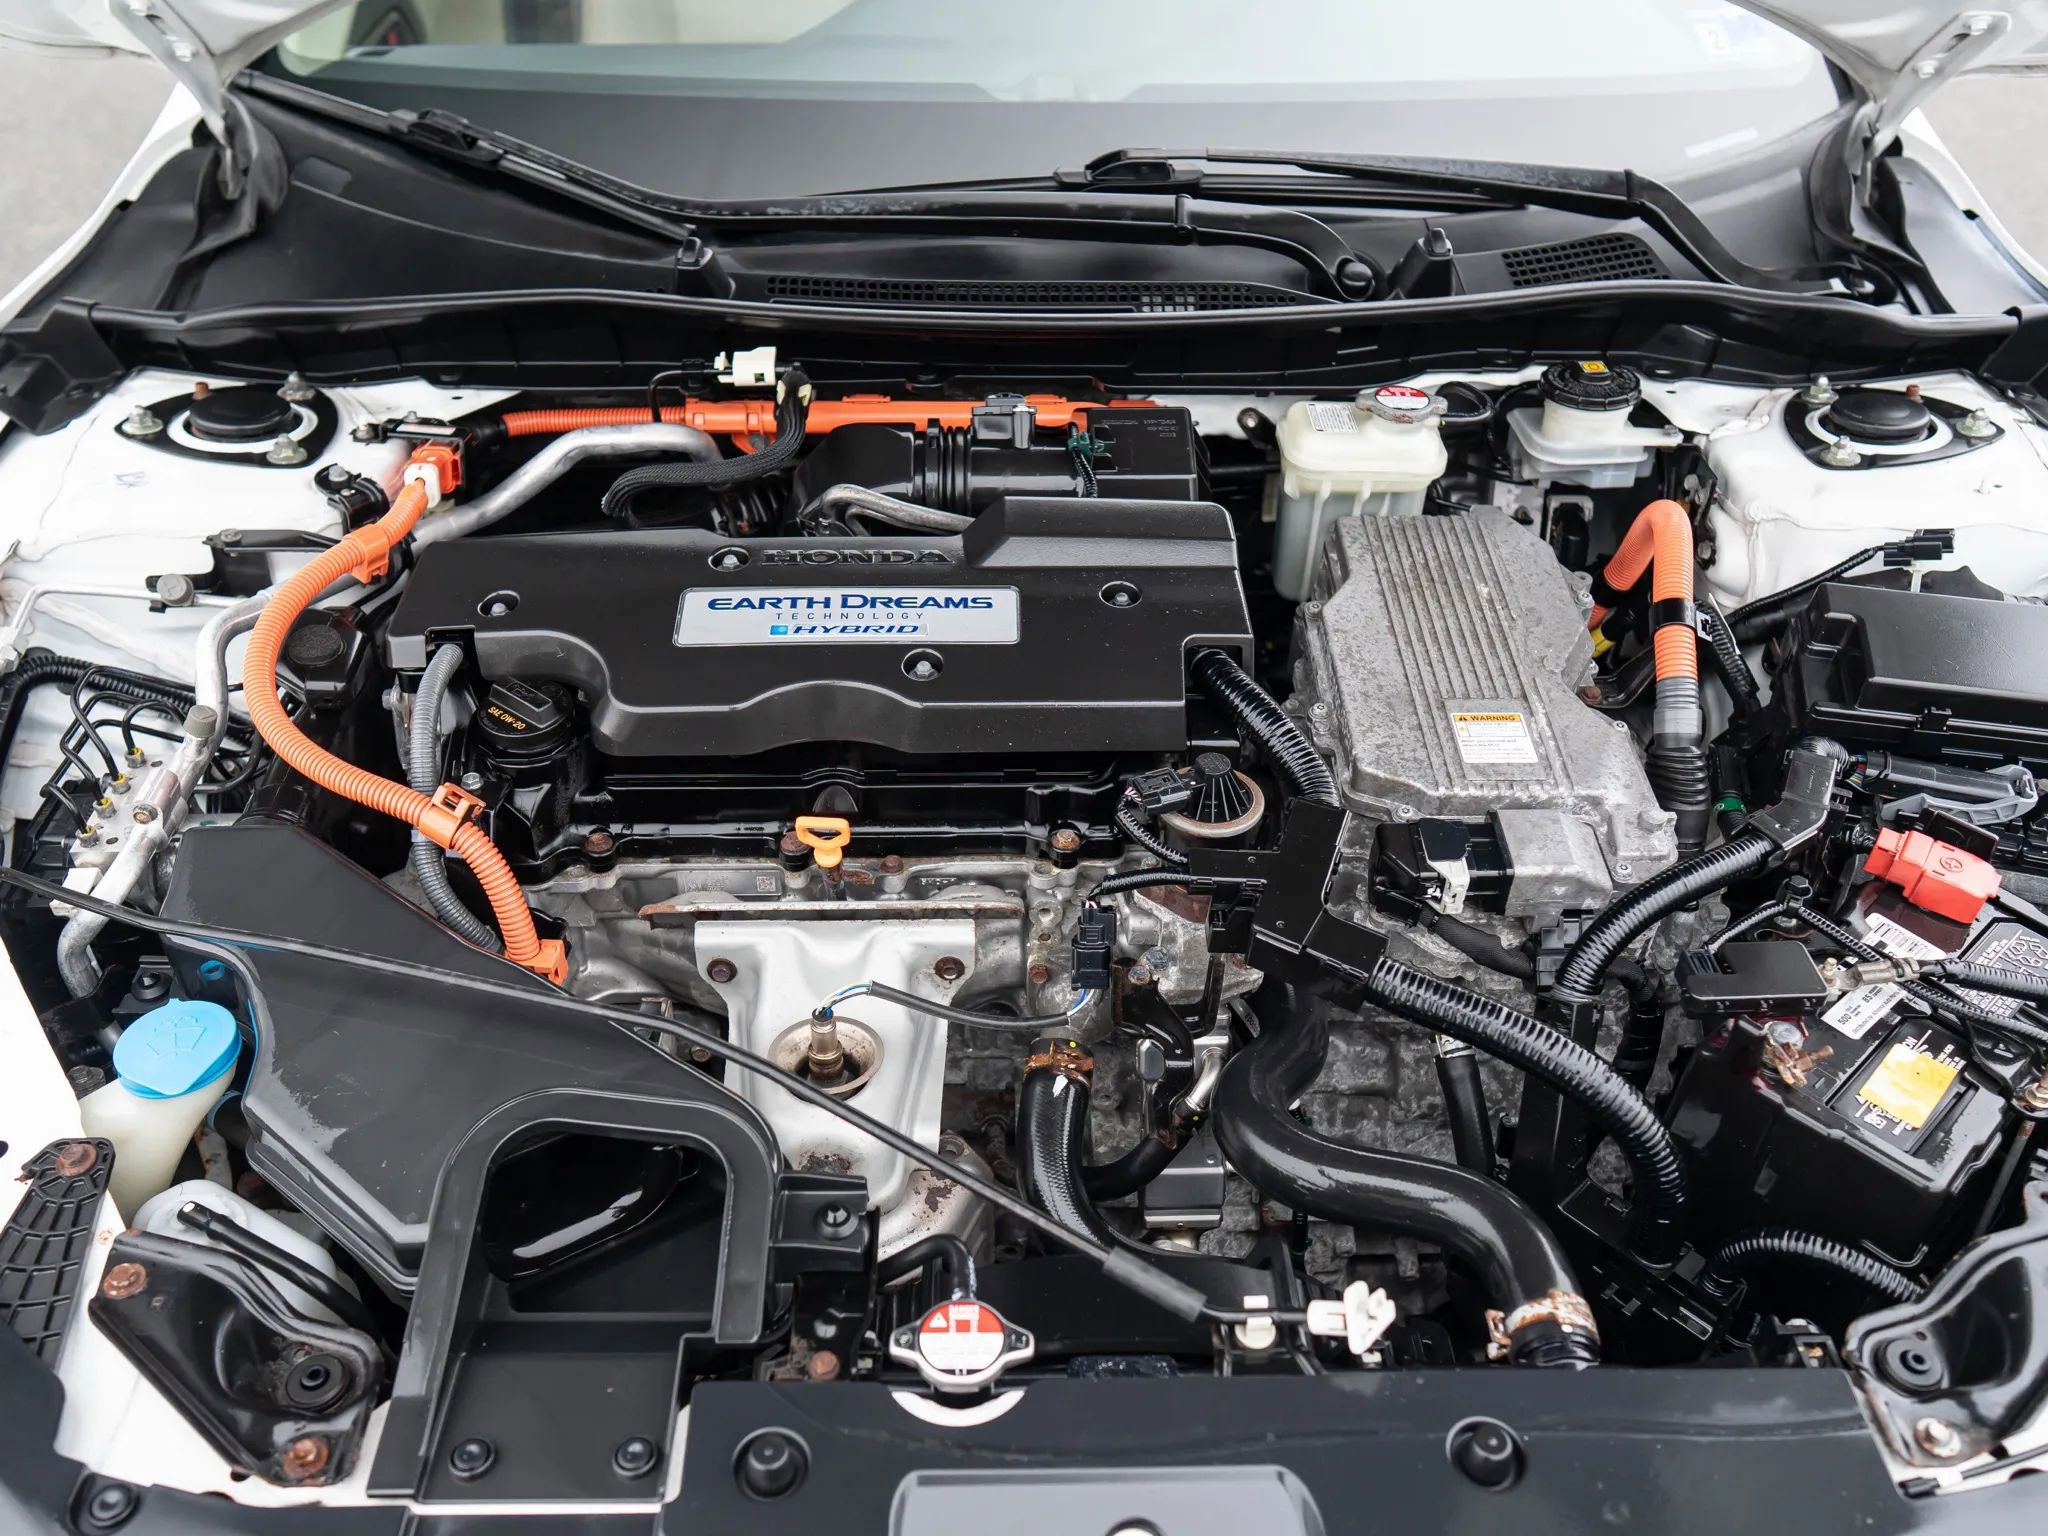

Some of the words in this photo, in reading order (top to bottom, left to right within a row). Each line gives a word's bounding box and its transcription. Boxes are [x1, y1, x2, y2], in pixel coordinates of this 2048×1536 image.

[761, 549, 956, 565] HONDA
[707, 597, 831, 610] EARTH
[840, 594, 993, 610] DREAMS
[776, 612, 925, 621] TECHNOLOGY
[793, 624, 919, 634] HYBRID
[488, 706, 503, 717] SAE
[1838, 1012, 1852, 1026] 500
